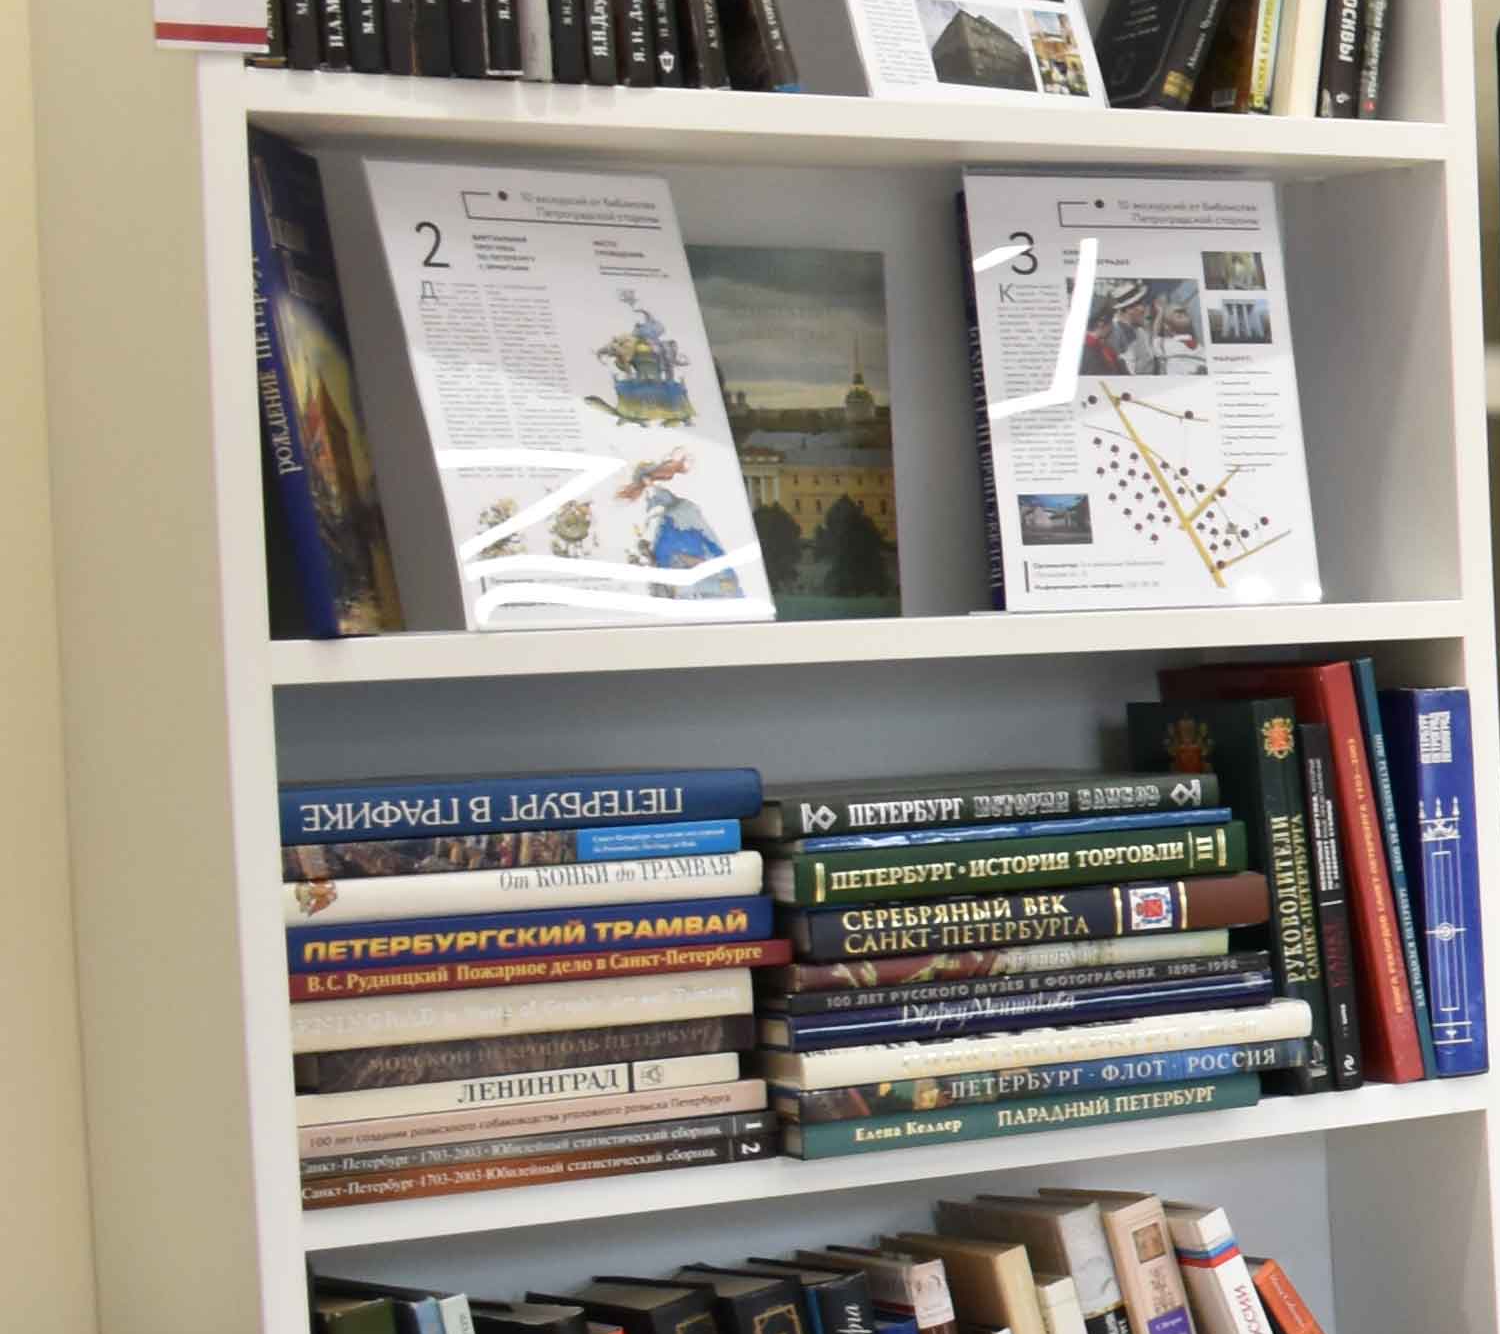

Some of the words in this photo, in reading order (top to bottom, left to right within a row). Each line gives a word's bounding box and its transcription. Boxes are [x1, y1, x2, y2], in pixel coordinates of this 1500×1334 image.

[415, 221, 451, 269] 2
[1007, 230, 1039, 277] 3
[299, 794, 460, 837] ГРАФИКЕ
[467, 792, 492, 826] В
[499, 780, 684, 824] ПЕТЕРБУРГ
[847, 795, 963, 828] ПЕТЕРБУРГ
[497, 869, 530, 894] От
[535, 862, 610, 891] КОНКИ
[638, 852, 734, 882] ТРАМВАЯ
[1075, 837, 1184, 869] ТОРГОВЛИ
[841, 896, 1013, 931] СЕРЕБРЯНЫЙ
[1022, 892, 1069, 918] ВЕК
[1269, 814, 1303, 983] РУКОВОДИТЕЛИ
[301, 917, 588, 966] ПЕТЕРБУРГСКИЙ
[592, 905, 750, 944] ТРАМВАЙ
[843, 913, 1090, 956] САНКТ-ПЕТЕРБУРГА
[304, 975, 323, 1000] В.
[325, 973, 344, 998] С.
[344, 965, 450, 997] Рудницкий
[454, 957, 547, 988] Пожарное
[548, 953, 594, 980] дело
[607, 939, 764, 975] Санкт-Петербурге
[826, 992, 854, 1012] 100
[856, 988, 886, 1009] ЛЕТ
[888, 980, 968, 1006] РУССКОГО
[1042, 960, 1157, 989] ФОТОГРАФИЯХ
[455, 1067, 620, 1104] ЛЕНИНГРАД
[1099, 1057, 1168, 1084] ФЛОТ
[1185, 1045, 1278, 1074] РОССИЯ
[853, 1122, 903, 1143] Елена
[904, 1114, 965, 1140] Келлер
[995, 1093, 1111, 1129] ПАРАДНЫЙ
[1113, 1082, 1218, 1114] ПЕТЕРБУРГ
[665, 1141, 717, 1166] сборник
[742, 1141, 761, 1156] 2
